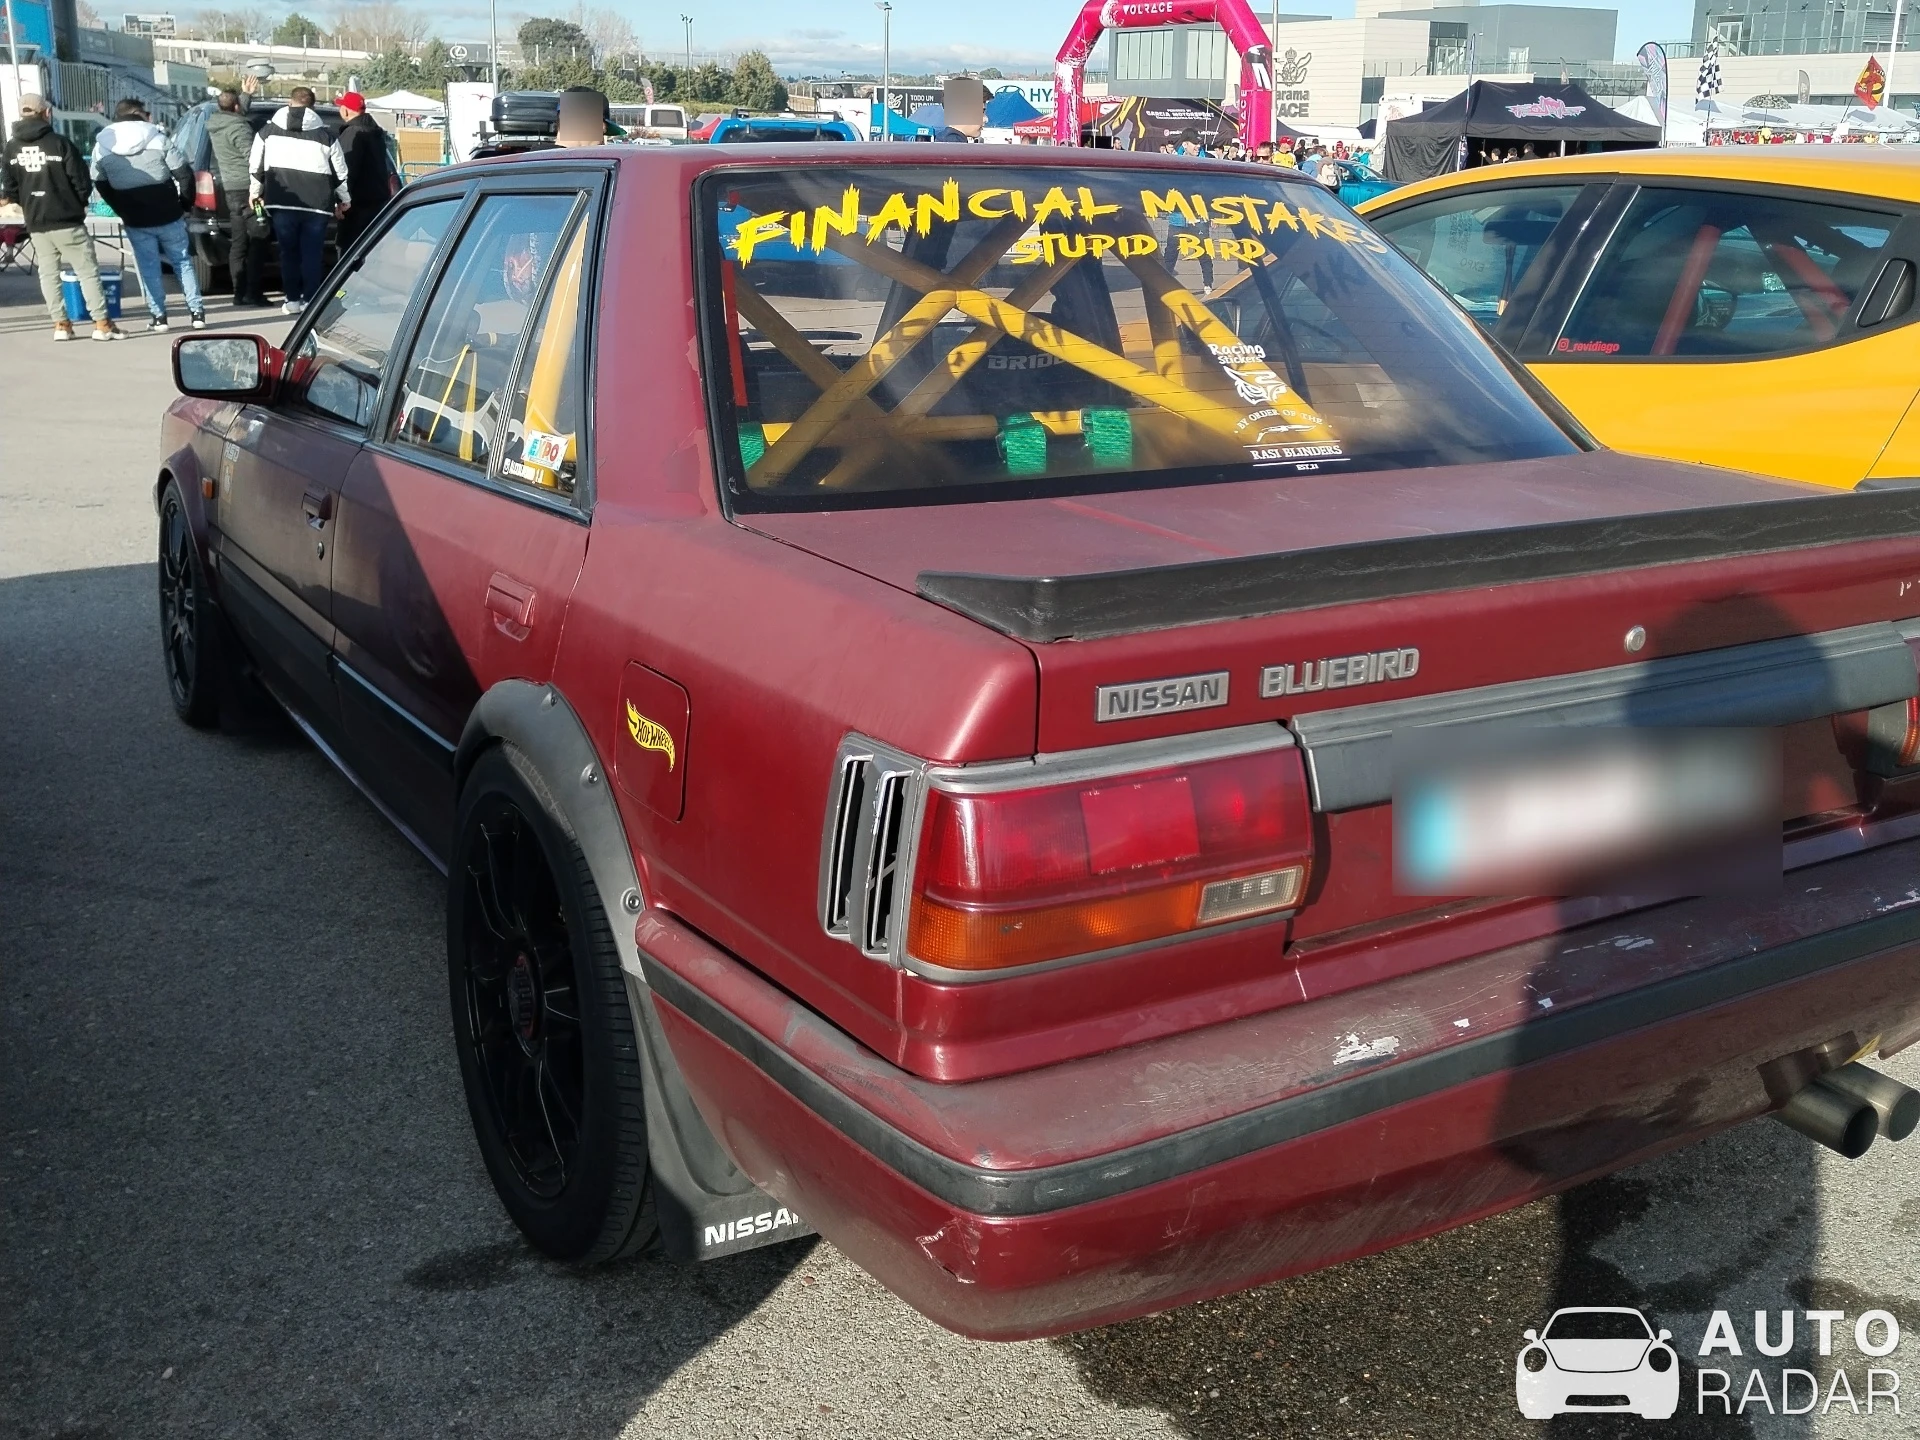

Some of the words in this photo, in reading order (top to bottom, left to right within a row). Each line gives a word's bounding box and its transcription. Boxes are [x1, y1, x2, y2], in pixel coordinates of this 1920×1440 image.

[1123, 2, 1173, 15] VOLRACE
[1276, 90, 1310, 101] arama
[1276, 103, 1309, 117] ACE
[726, 177, 1122, 269] FINANCIAL
[1140, 188, 1388, 254] MISTAKES
[1011, 231, 1158, 267] STUPID
[1175, 234, 1266, 266] BIRD
[1207, 342, 1266, 359] Racing
[1218, 354, 1263, 365] Stickers
[1237, 418, 1250, 430] BY
[1249, 409, 1280, 422] ORDER
[1283, 409, 1296, 417] OF
[1301, 413, 1323, 425] THE
[1250, 448, 1281, 460] RASI
[1284, 445, 1343, 458] BLINDERS
[1108, 677, 1220, 716] NISSAN
[1260, 648, 1420, 699] BLUEBIRD
